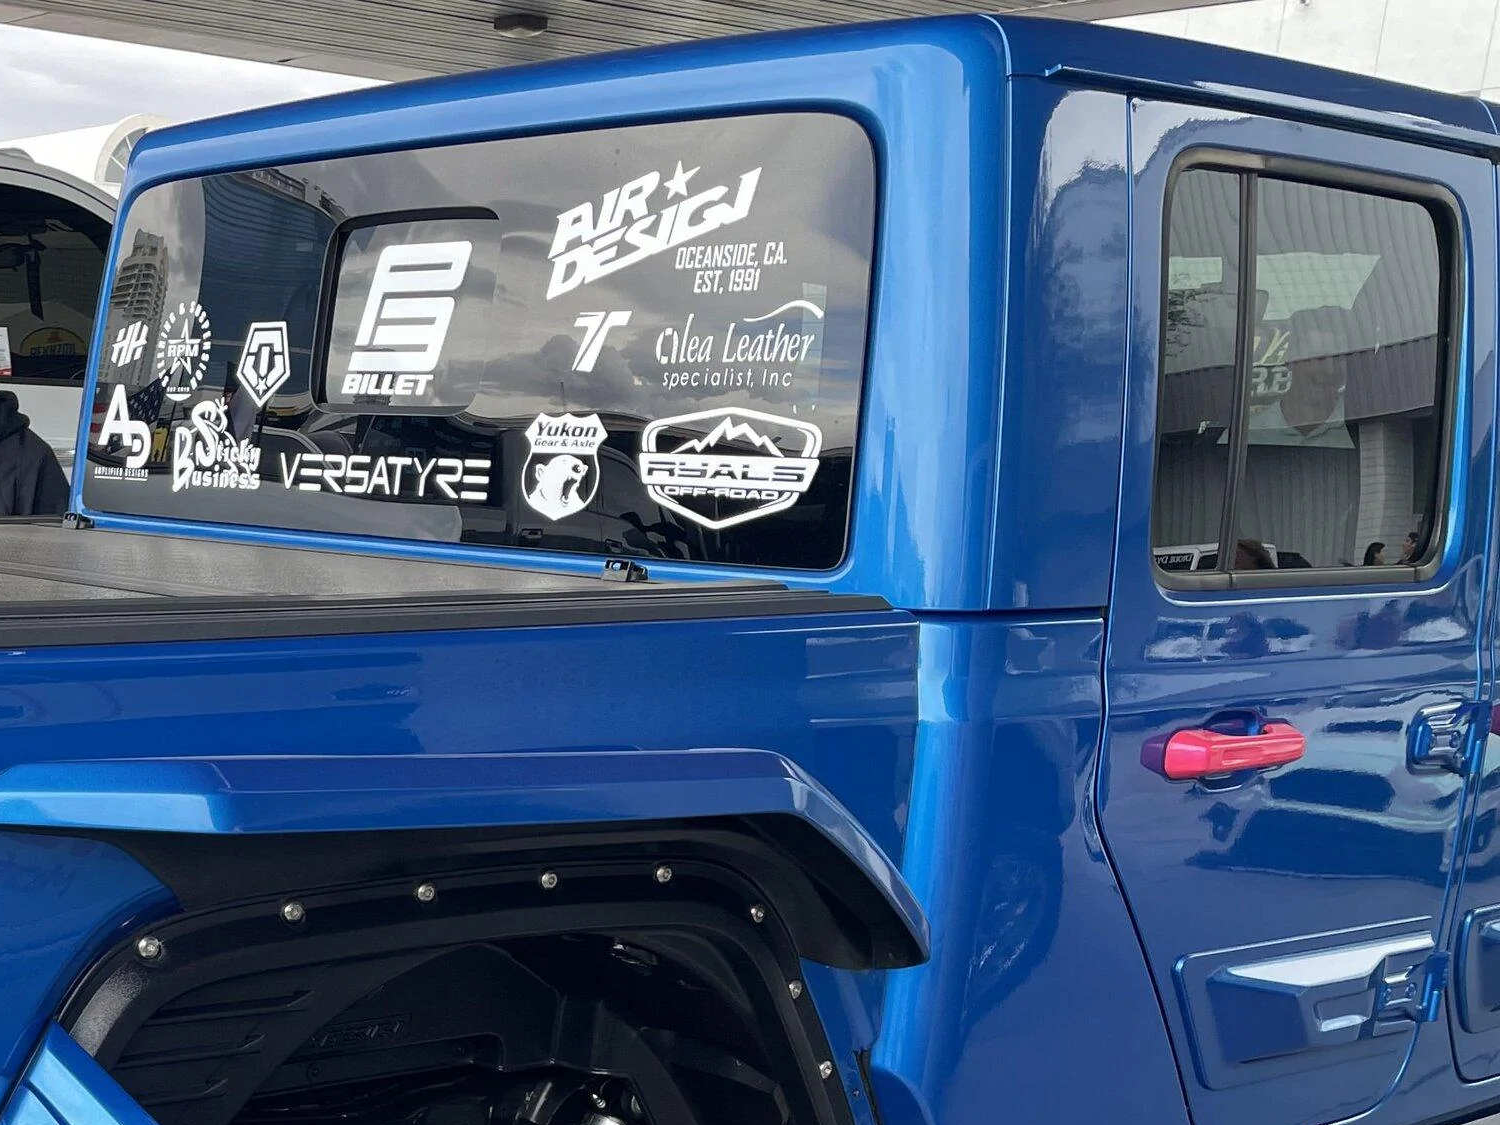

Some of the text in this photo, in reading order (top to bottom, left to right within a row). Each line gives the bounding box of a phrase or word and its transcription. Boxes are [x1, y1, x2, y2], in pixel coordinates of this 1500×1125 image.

[547, 171, 661, 259] AIR
[675, 241, 788, 269] OCEANSIDE, CA.
[693, 268, 761, 295] EST, 1991
[167, 344, 200, 357] RPM
[721, 322, 816, 364] Leather
[341, 373, 434, 396] BILLET
[661, 368, 793, 390] specialist, Inc
[192, 400, 262, 472] Sticky
[534, 438, 596, 448] Gear & Axle
[537, 421, 599, 438] Yukon
[172, 426, 262, 493] Business
[280, 452, 492, 501] VERSATYRE
[663, 485, 780, 501] OFF-ROAD
